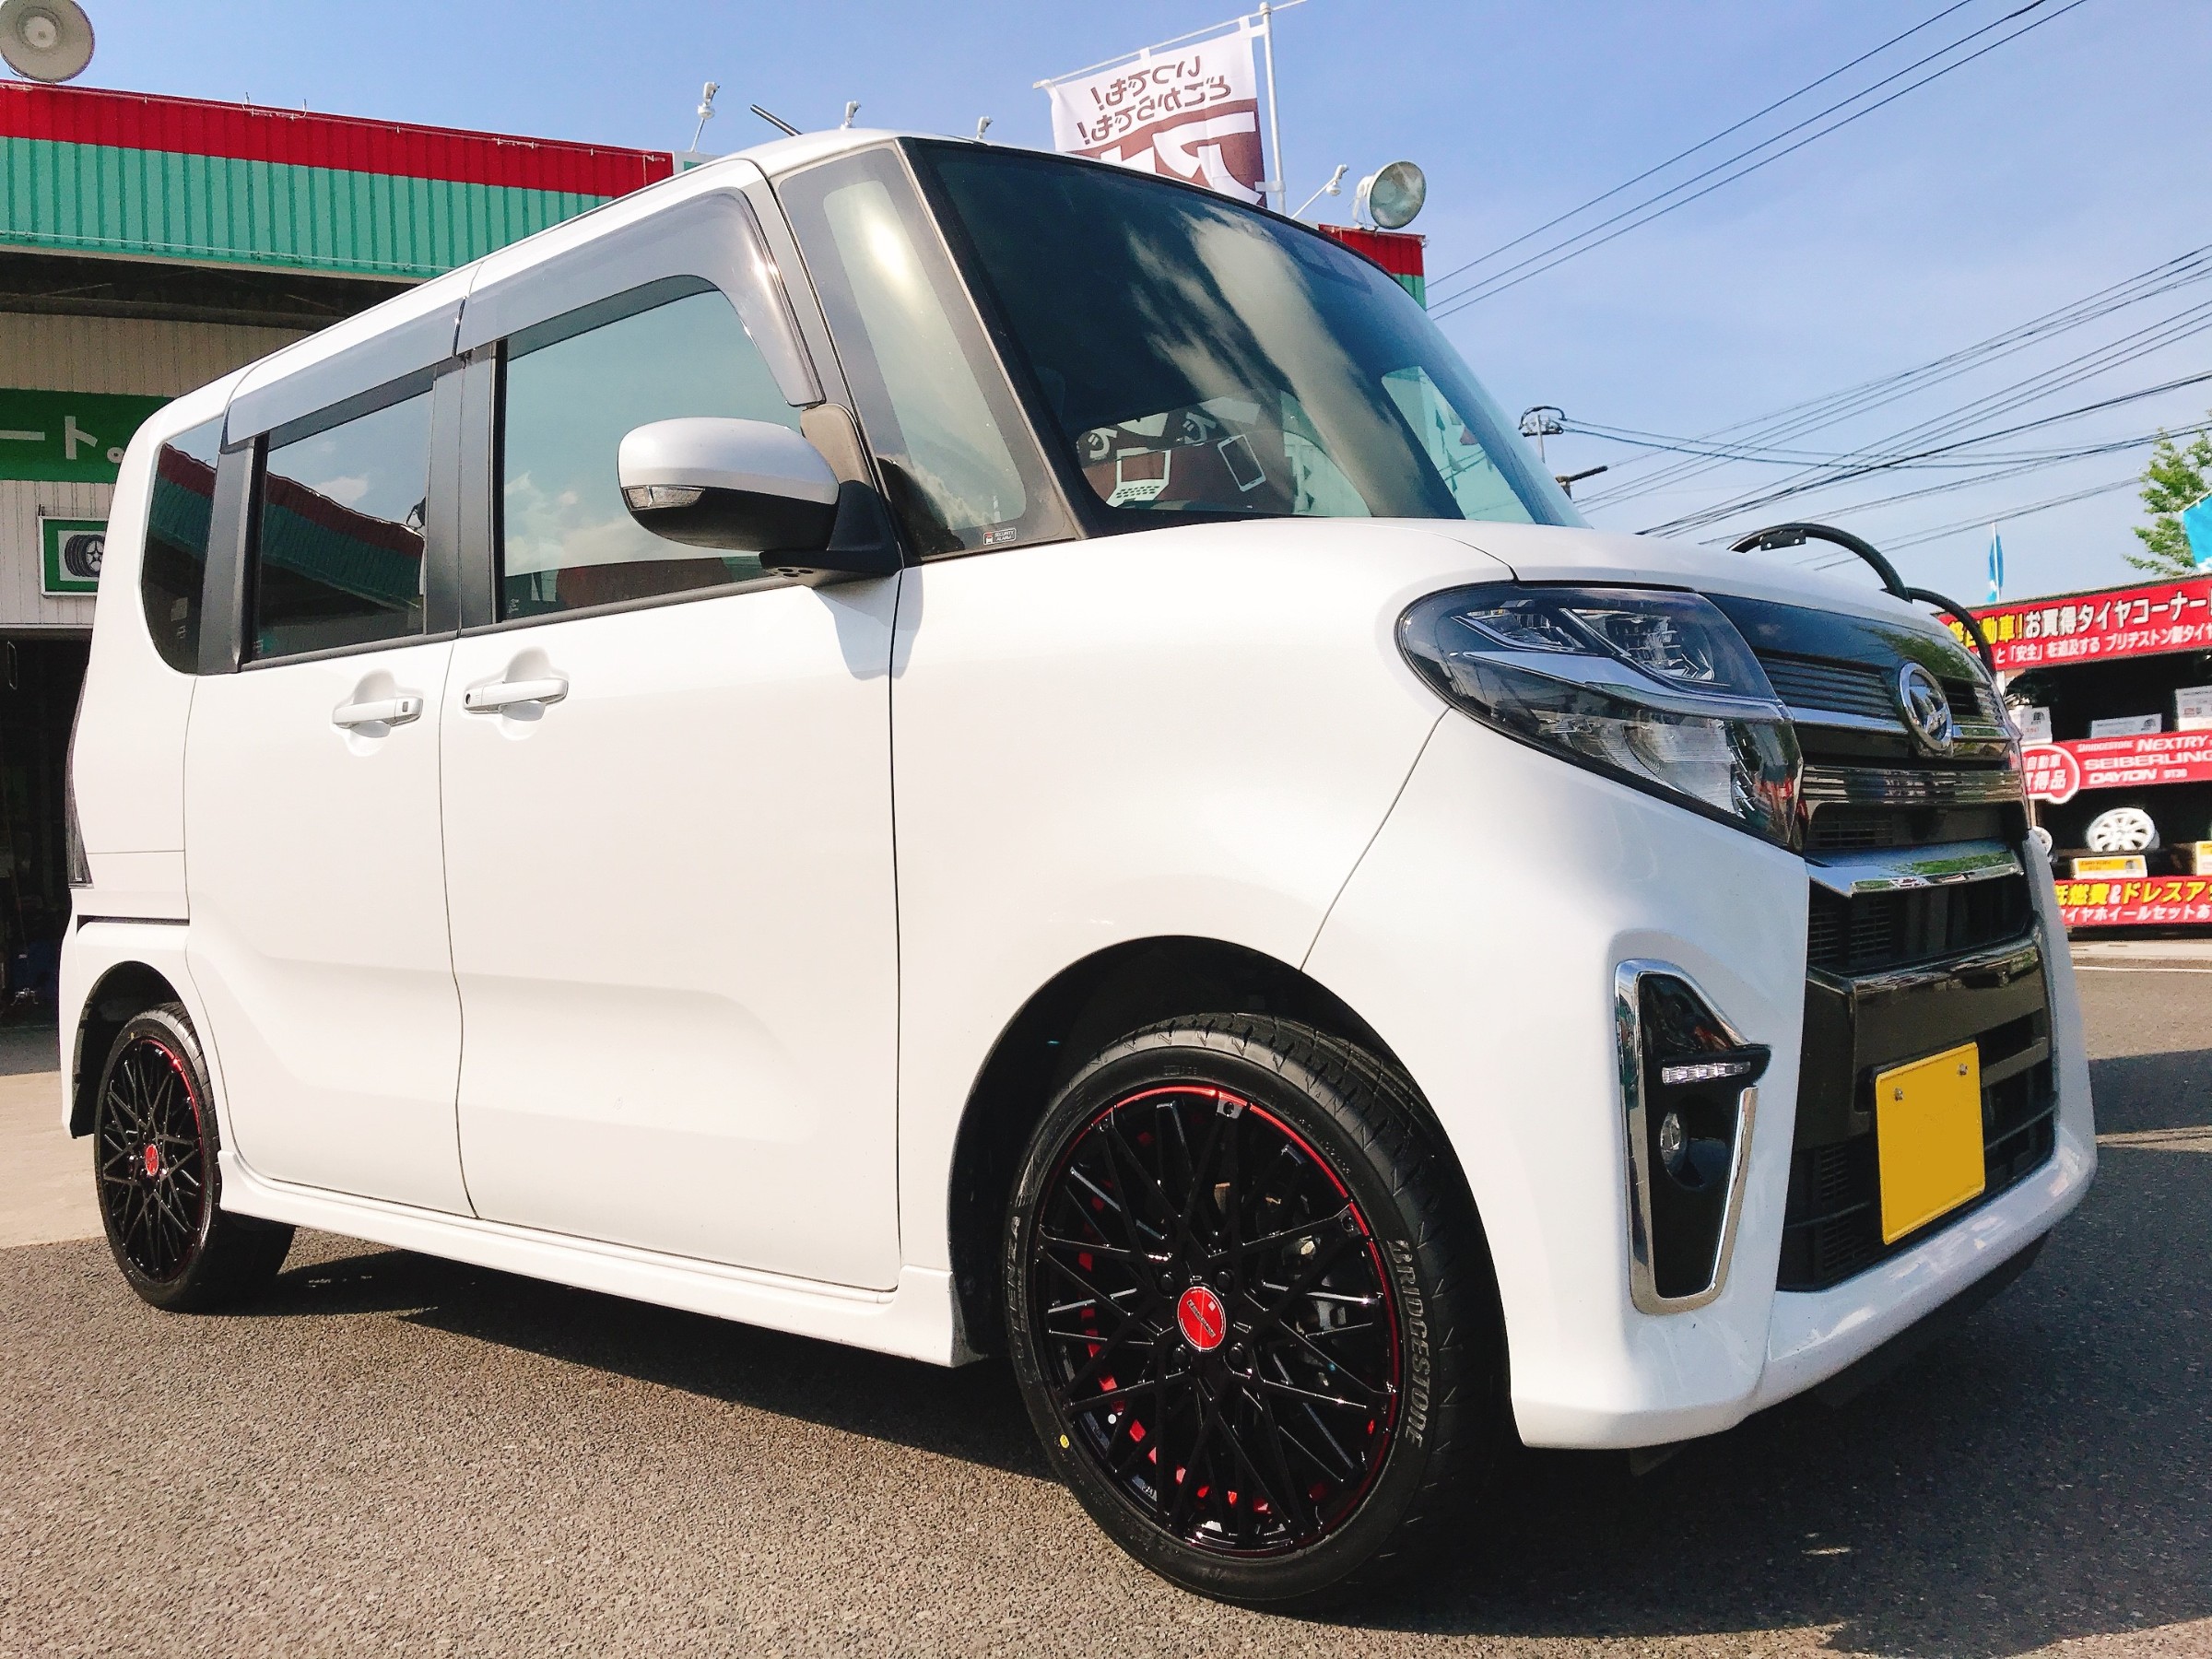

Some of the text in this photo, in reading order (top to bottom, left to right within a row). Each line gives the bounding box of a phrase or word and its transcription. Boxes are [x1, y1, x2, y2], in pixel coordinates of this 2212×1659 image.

[2136, 735, 2208, 752] NEXTRY
[2088, 768, 2158, 784] DAYTON
[1386, 1240, 1431, 1449] BRIDGESTONE
